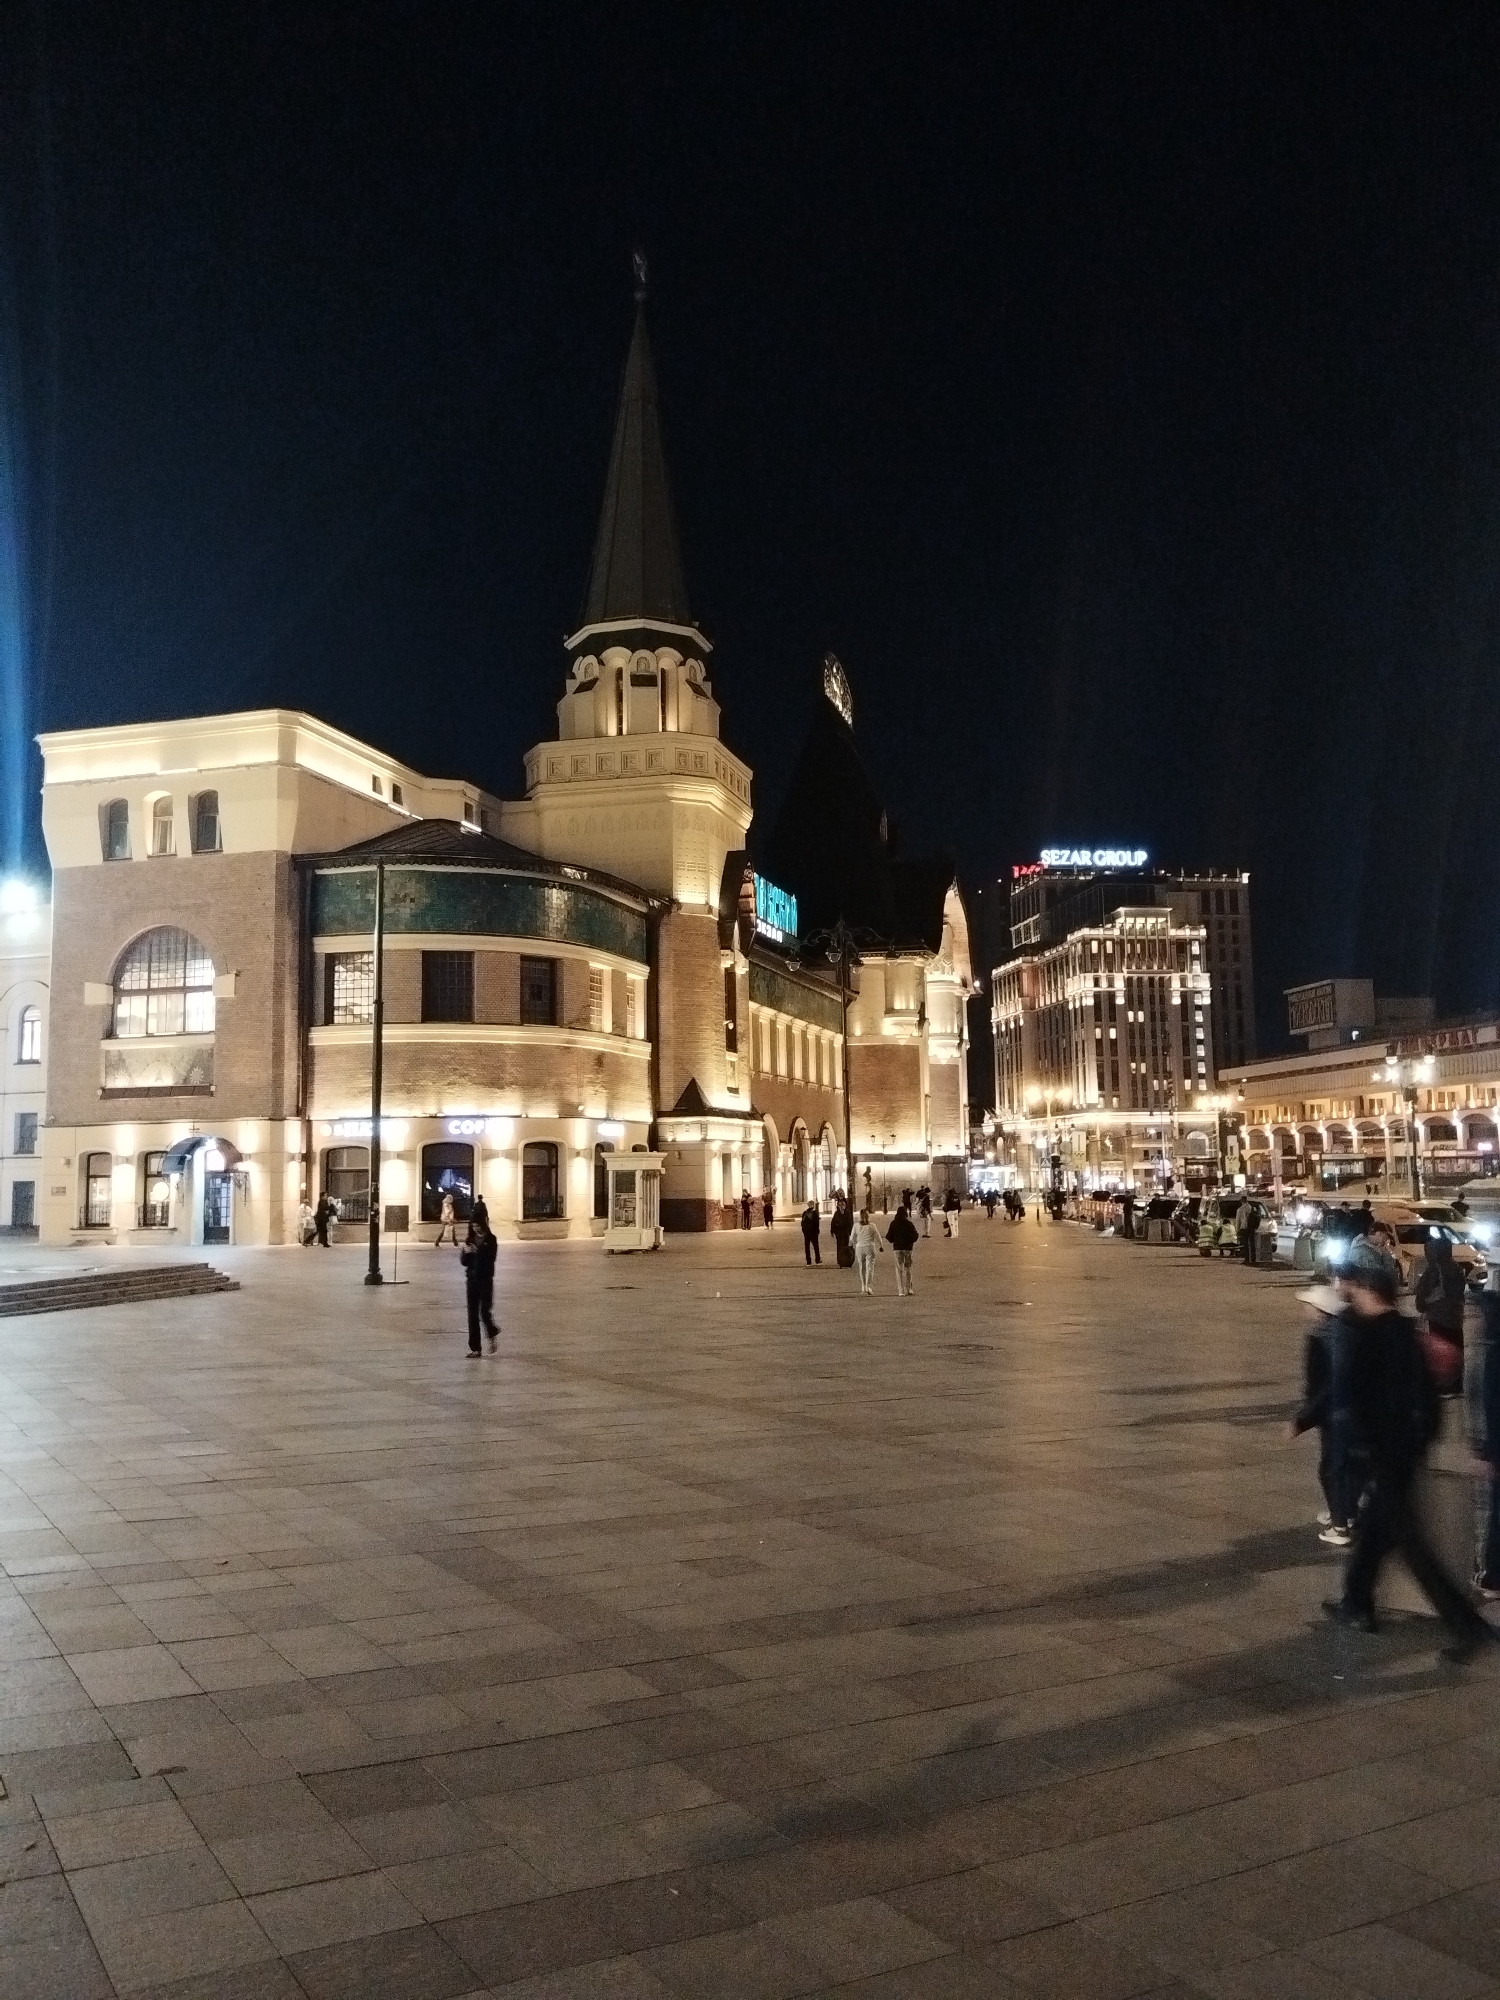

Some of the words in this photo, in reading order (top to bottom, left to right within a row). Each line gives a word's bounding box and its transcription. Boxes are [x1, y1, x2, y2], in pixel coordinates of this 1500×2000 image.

[1041, 849, 1092, 865] SEZAR
[1093, 850, 1147, 866] GROUP
[448, 1119, 515, 1135] COF
